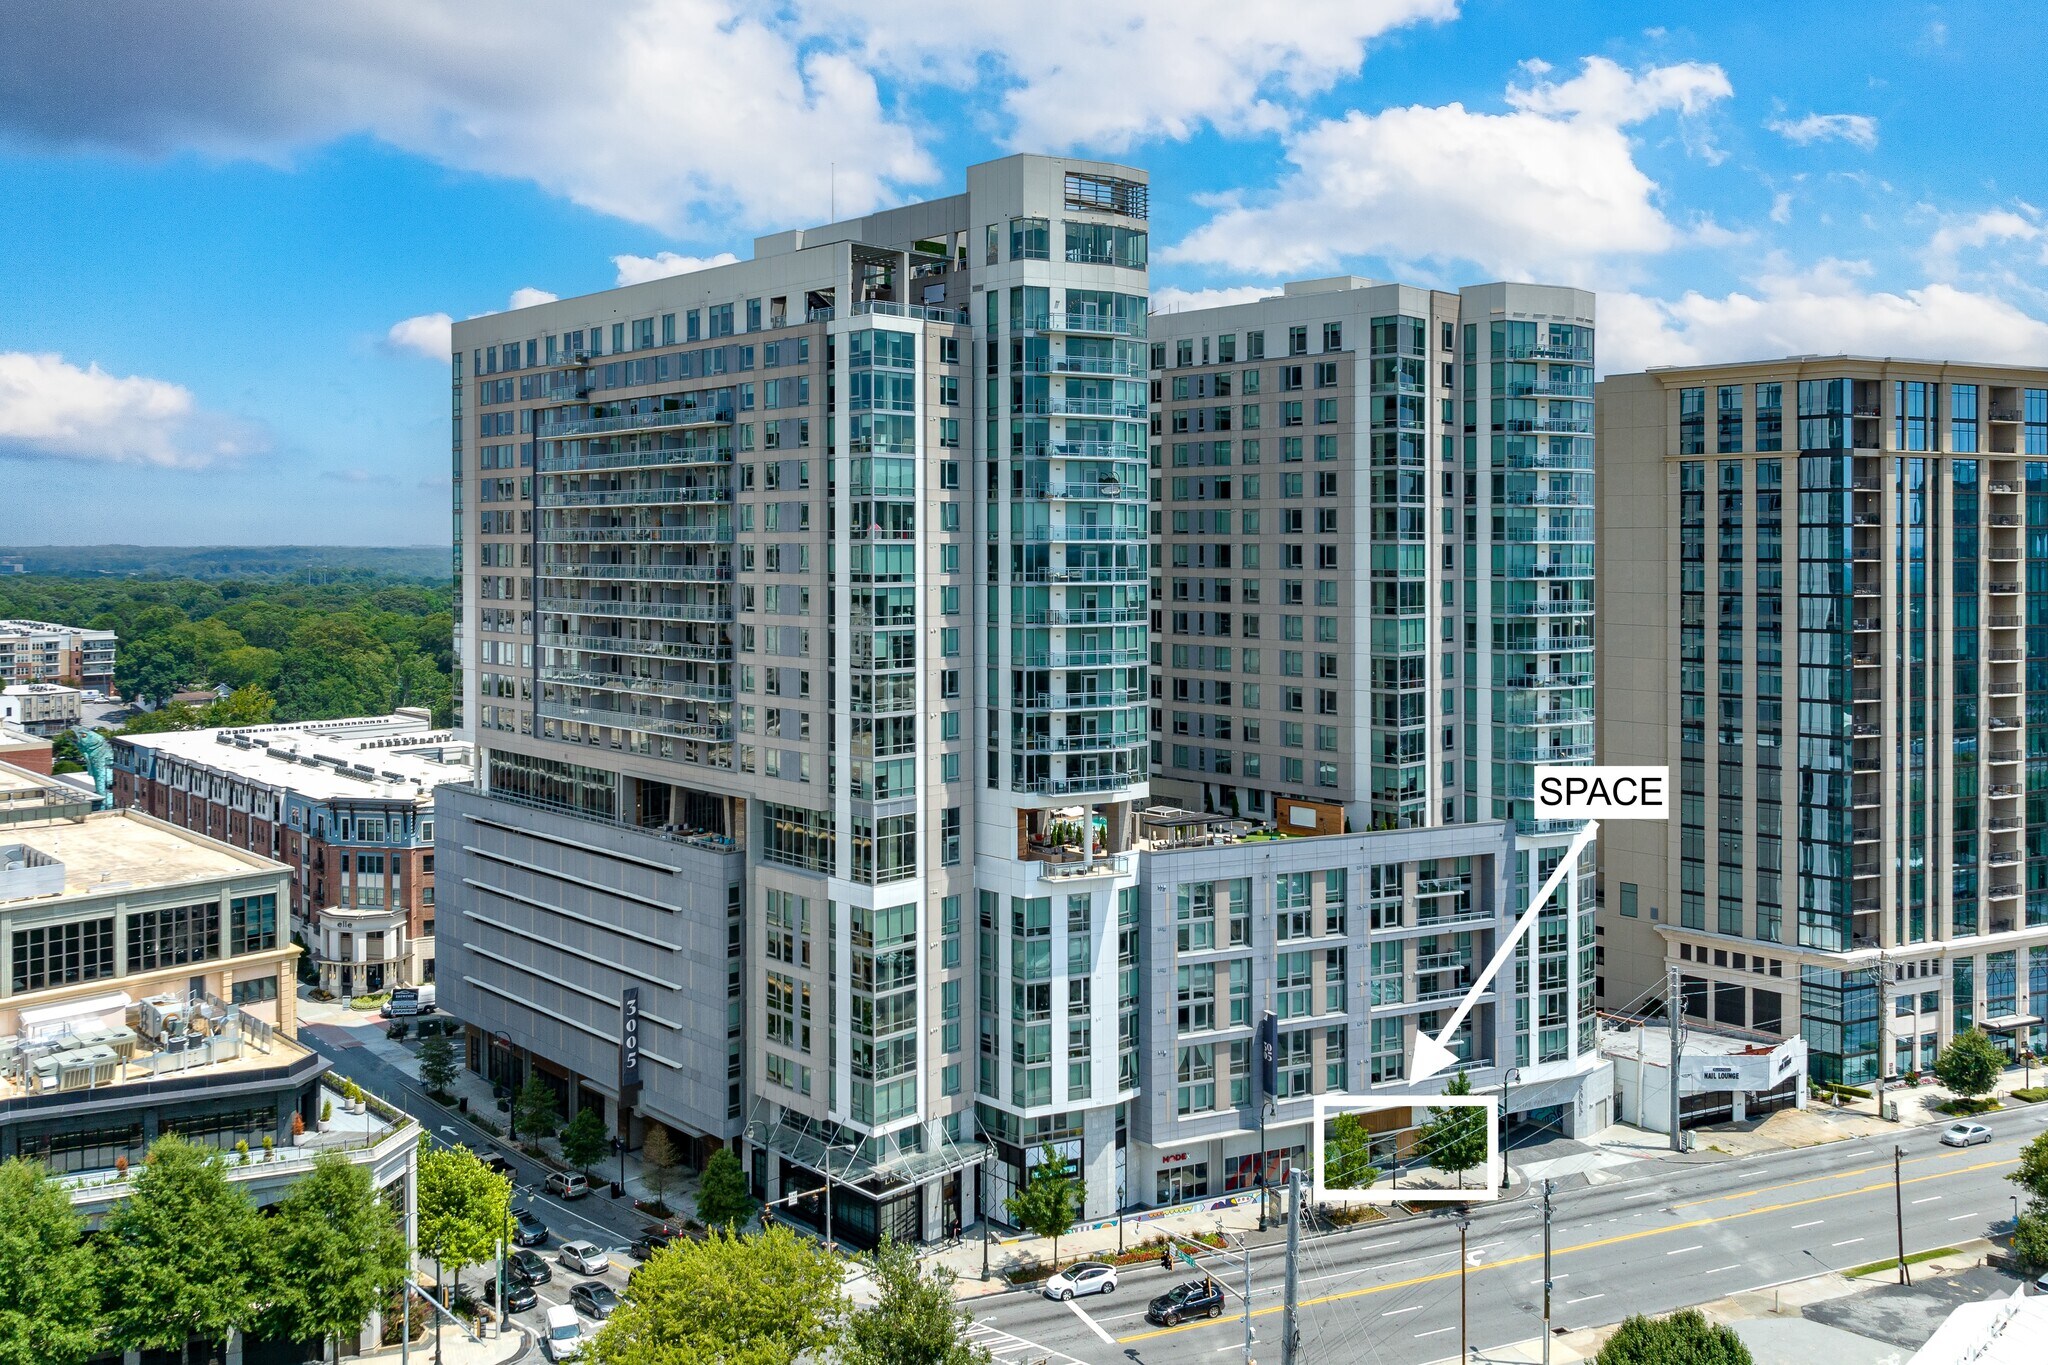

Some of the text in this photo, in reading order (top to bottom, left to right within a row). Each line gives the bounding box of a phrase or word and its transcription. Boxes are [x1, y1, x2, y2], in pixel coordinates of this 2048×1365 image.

[337, 920, 353, 928] elle
[626, 999, 637, 1068] 3005
[1703, 1072, 1740, 1080] NAIL LOUNGE
